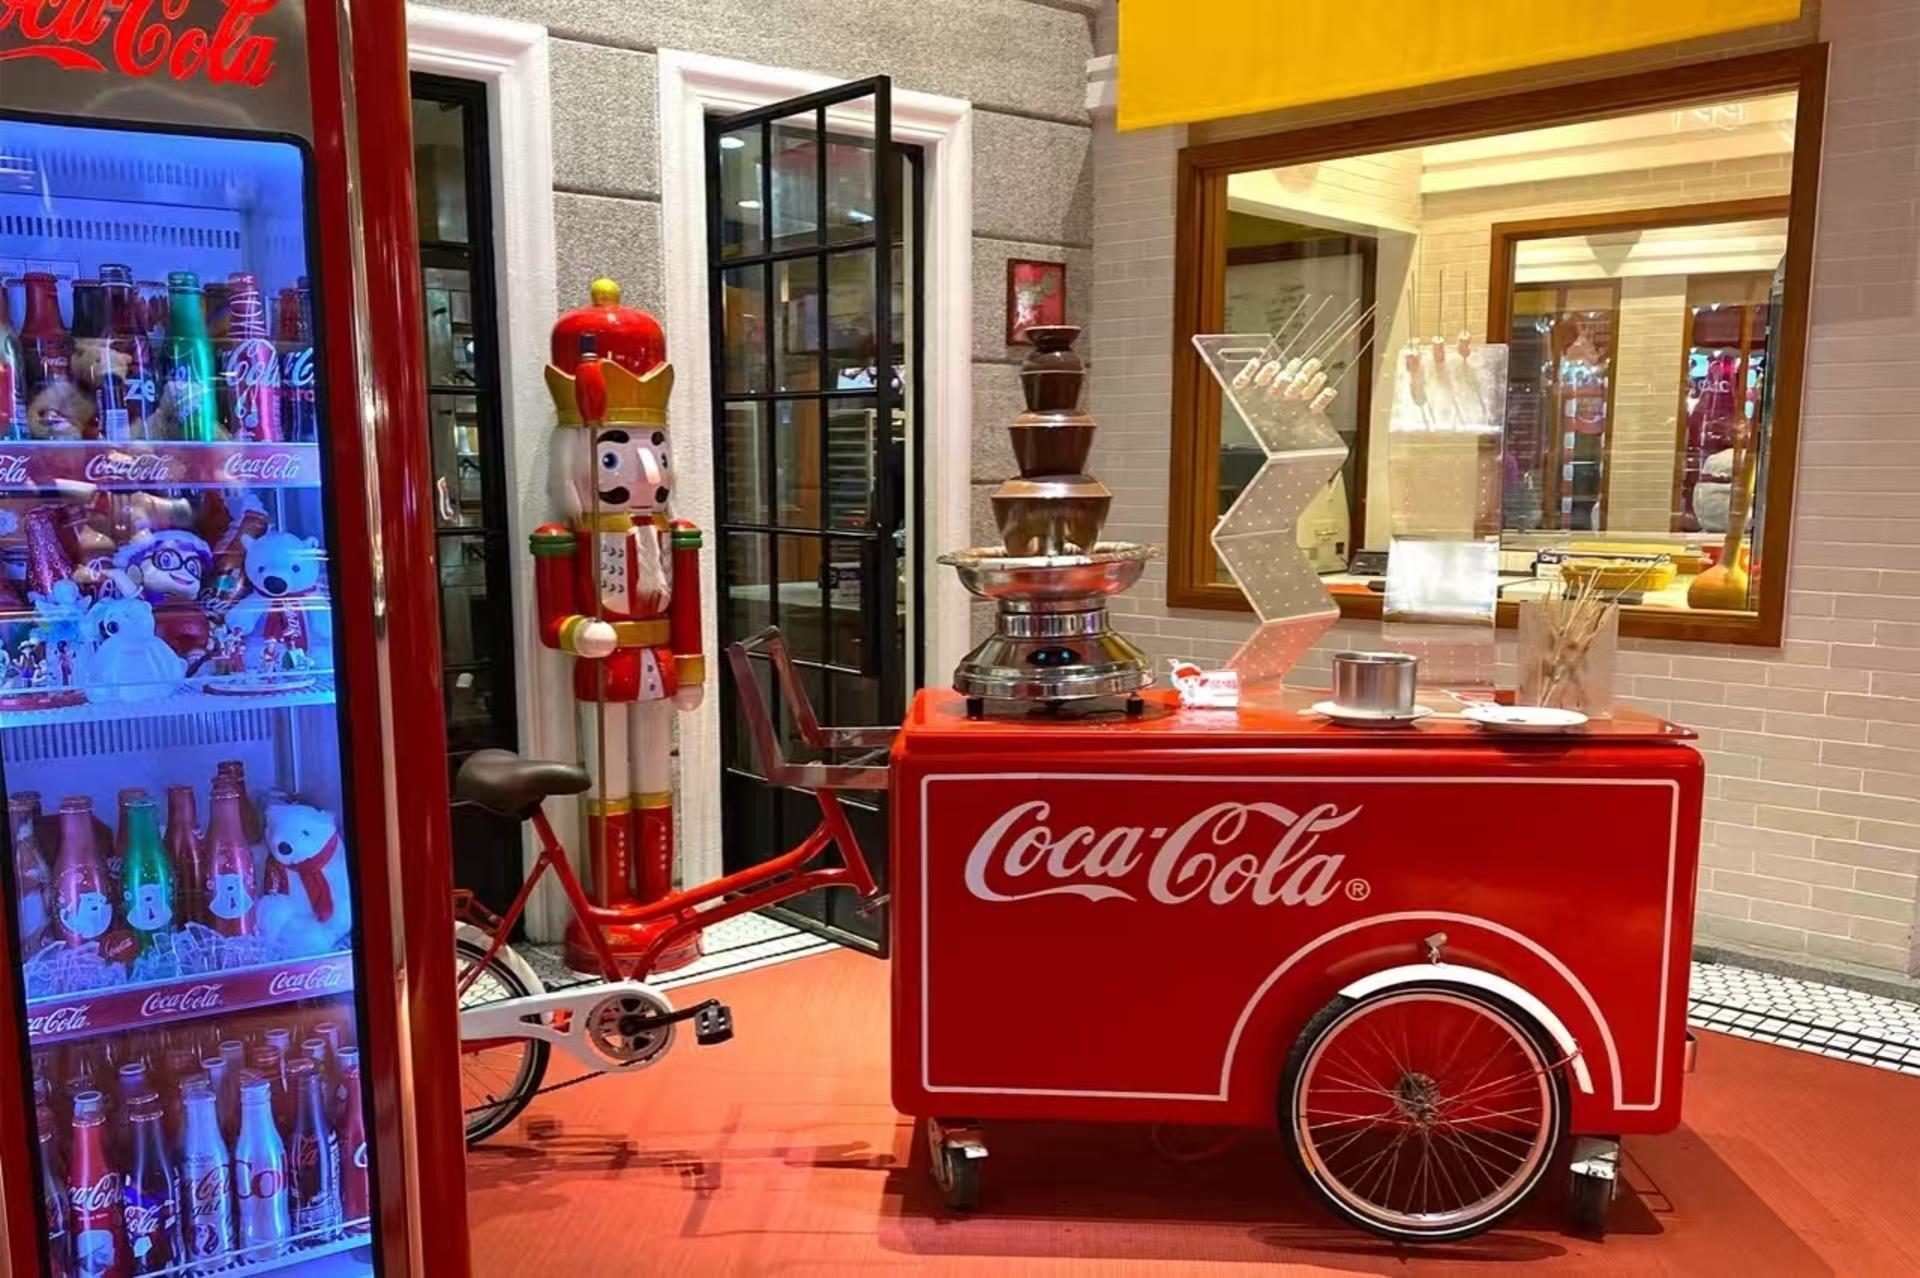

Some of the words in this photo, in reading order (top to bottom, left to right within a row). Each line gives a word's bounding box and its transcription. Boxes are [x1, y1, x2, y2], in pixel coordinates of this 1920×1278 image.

[0, 0, 276, 88] ca-Cola
[85, 454, 172, 481] Coca-Cola
[224, 453, 301, 479] Coca-Cola
[964, 800, 1363, 906] Coca-Cola
[269, 965, 341, 995] Coca-Cola
[141, 984, 223, 1016] Coca-Cola
